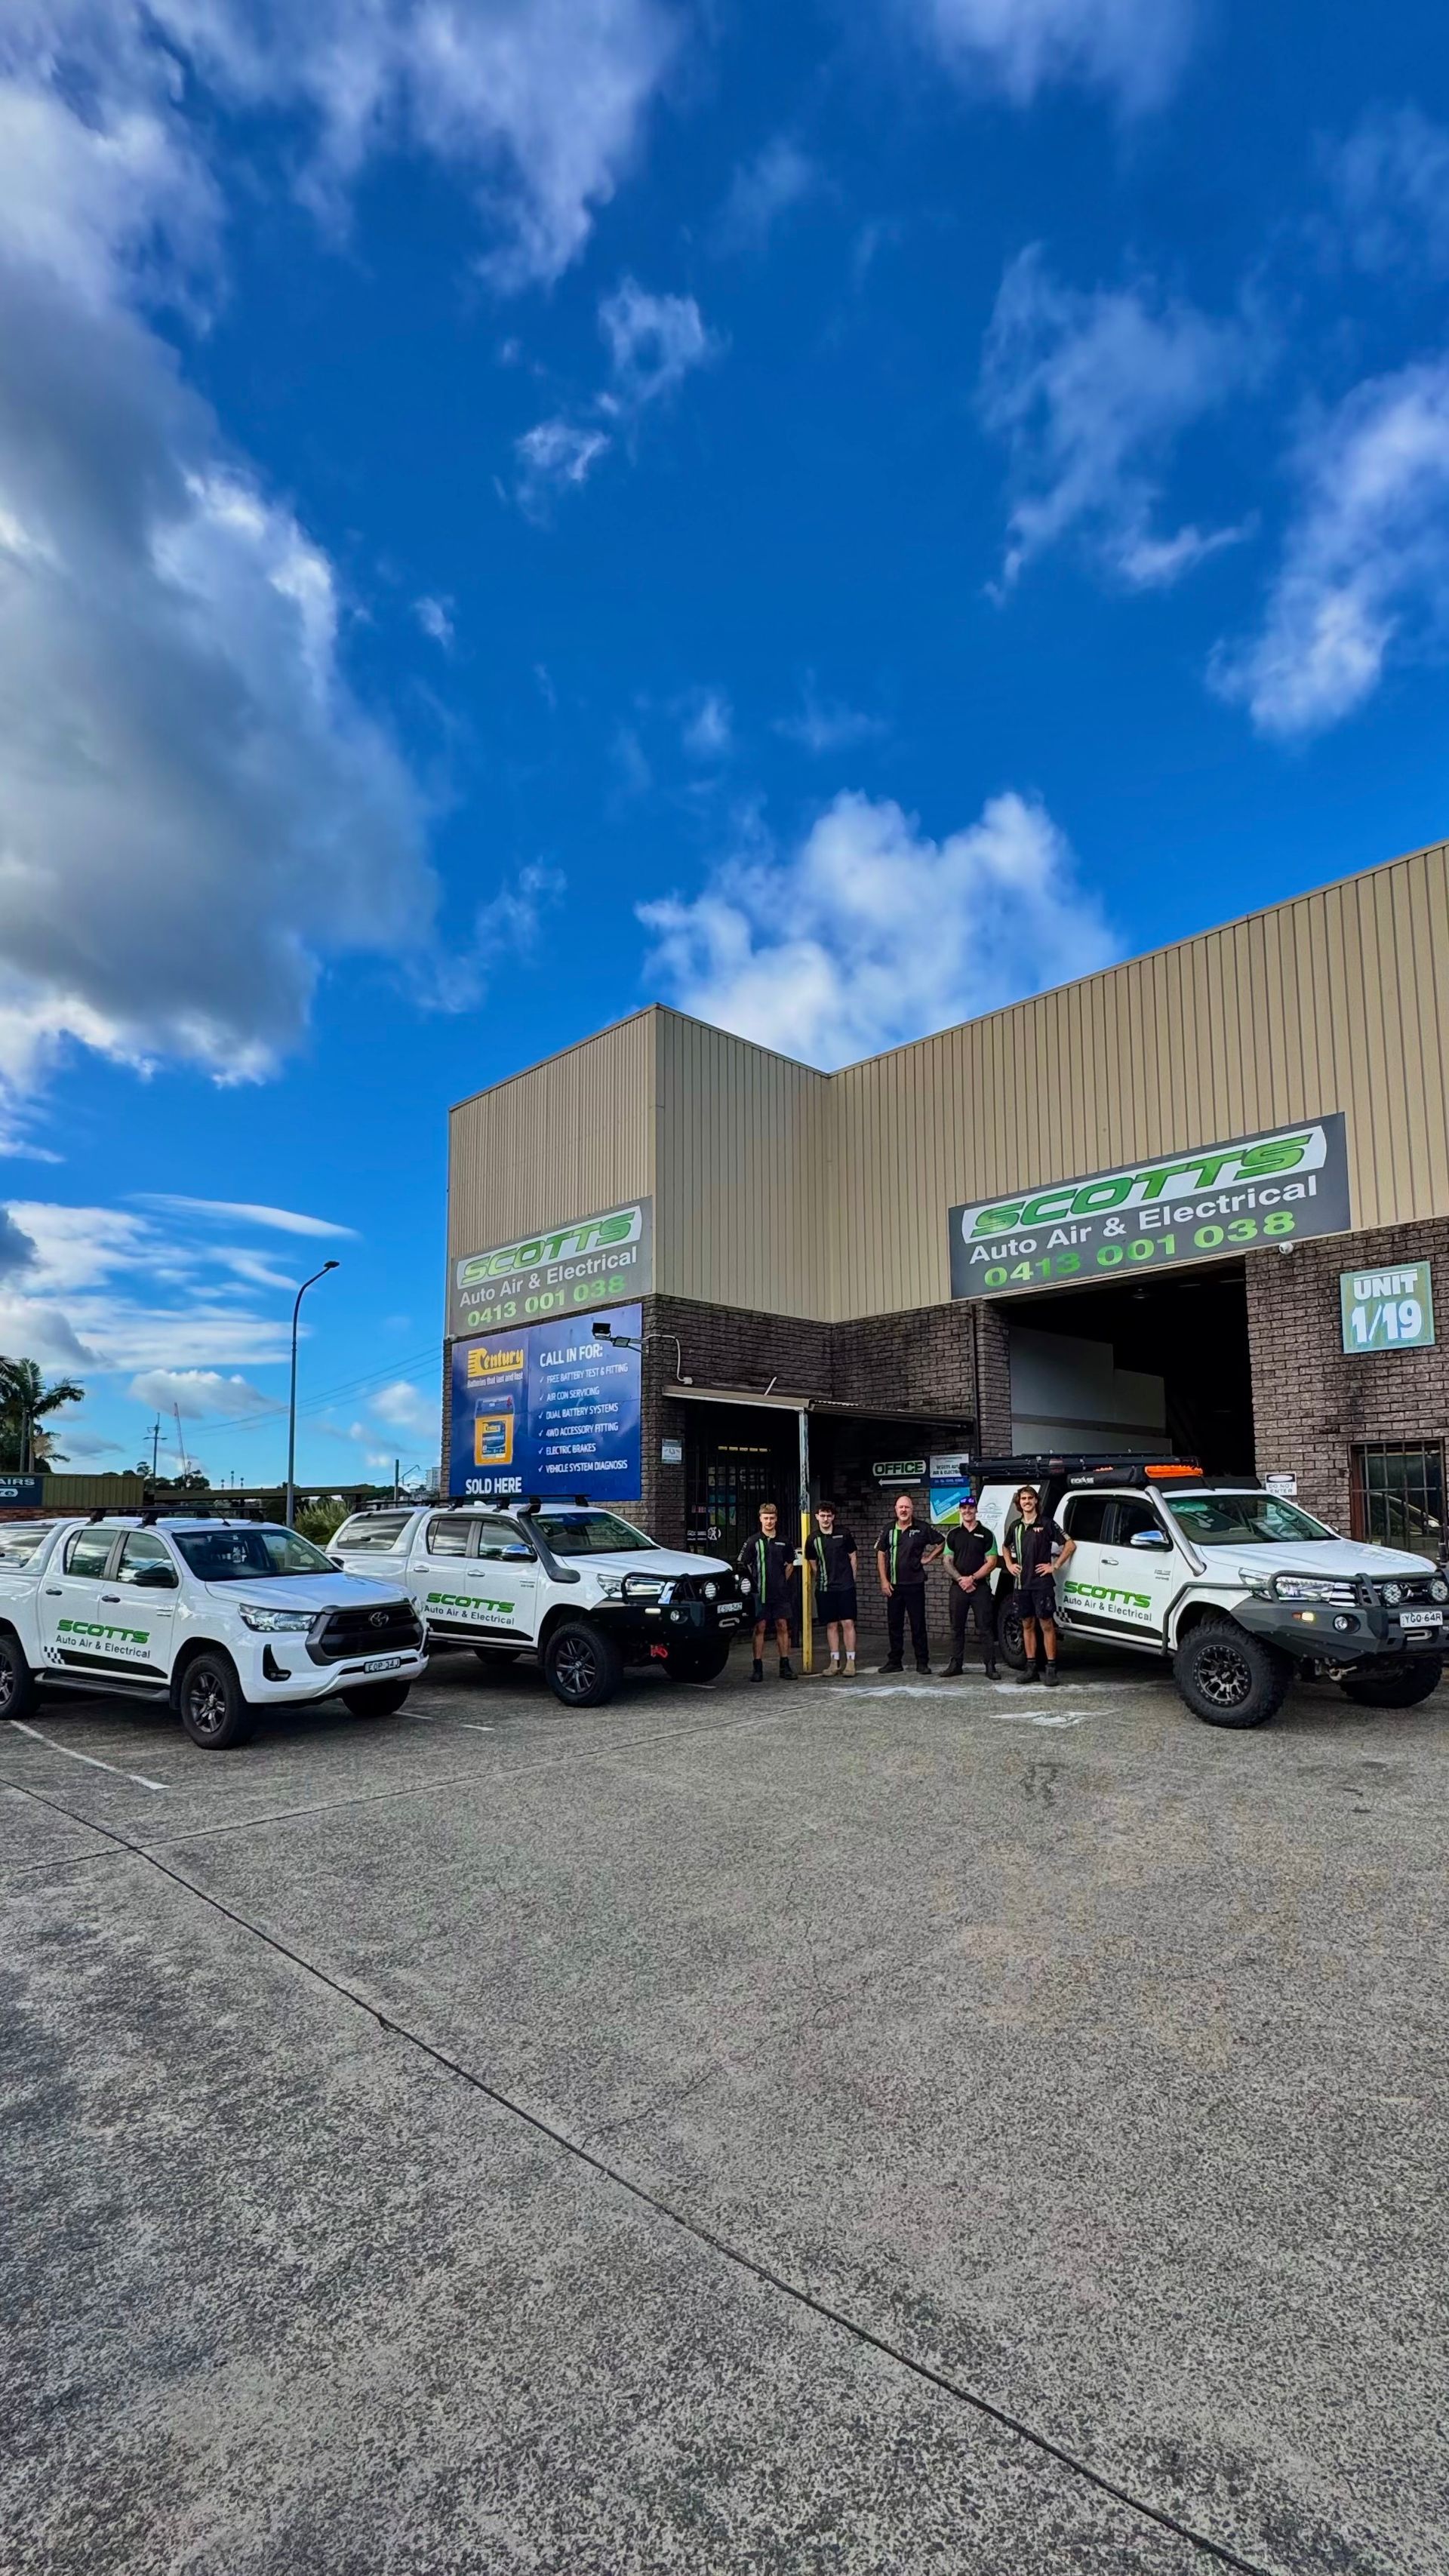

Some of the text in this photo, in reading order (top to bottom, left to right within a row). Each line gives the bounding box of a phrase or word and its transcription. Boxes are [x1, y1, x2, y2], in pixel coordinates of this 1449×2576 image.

[970, 1134, 1313, 1238] SCOTTS
[969, 1174, 1317, 1265] Auto Air & Electrical
[462, 1211, 635, 1284] SCOTTS
[983, 1211, 1296, 1288] 0413 001 038
[460, 1246, 637, 1307] Auto Air & Electrical
[1353, 1272, 1418, 1300] UNIT
[467, 1274, 626, 1327] 0413 001 038
[1352, 1300, 1422, 1343] 1/19
[468, 1347, 524, 1378] Century
[540, 1343, 603, 1368] CALL IN FOR:
[546, 1363, 629, 1383] FREE BATTERY TEST & FITTING
[546, 1386, 600, 1402] AIR CON SERVICING
[546, 1402, 619, 1420] DUAL BATTERY SYSTEMS
[546, 1422, 619, 1437] 4WD ACCESSORY FITTING
[546, 1443, 596, 1455] ELECTRIC BRAKES
[546, 1460, 628, 1473] VEHICLE SYSTEM DIAGNOSIS
[875, 1461, 923, 1475] OFFICE
[466, 1476, 522, 1494] SOLD HERE
[426, 1592, 515, 1614] SCOTTS
[1063, 1580, 1152, 1608] SCOTTS
[424, 1605, 515, 1625] Auto Air & Electrical
[1063, 1595, 1152, 1621] Auto Air & Electrical
[57, 1619, 150, 1644] SCOTTS
[55, 1635, 151, 1658] Auto Air & Electrical
